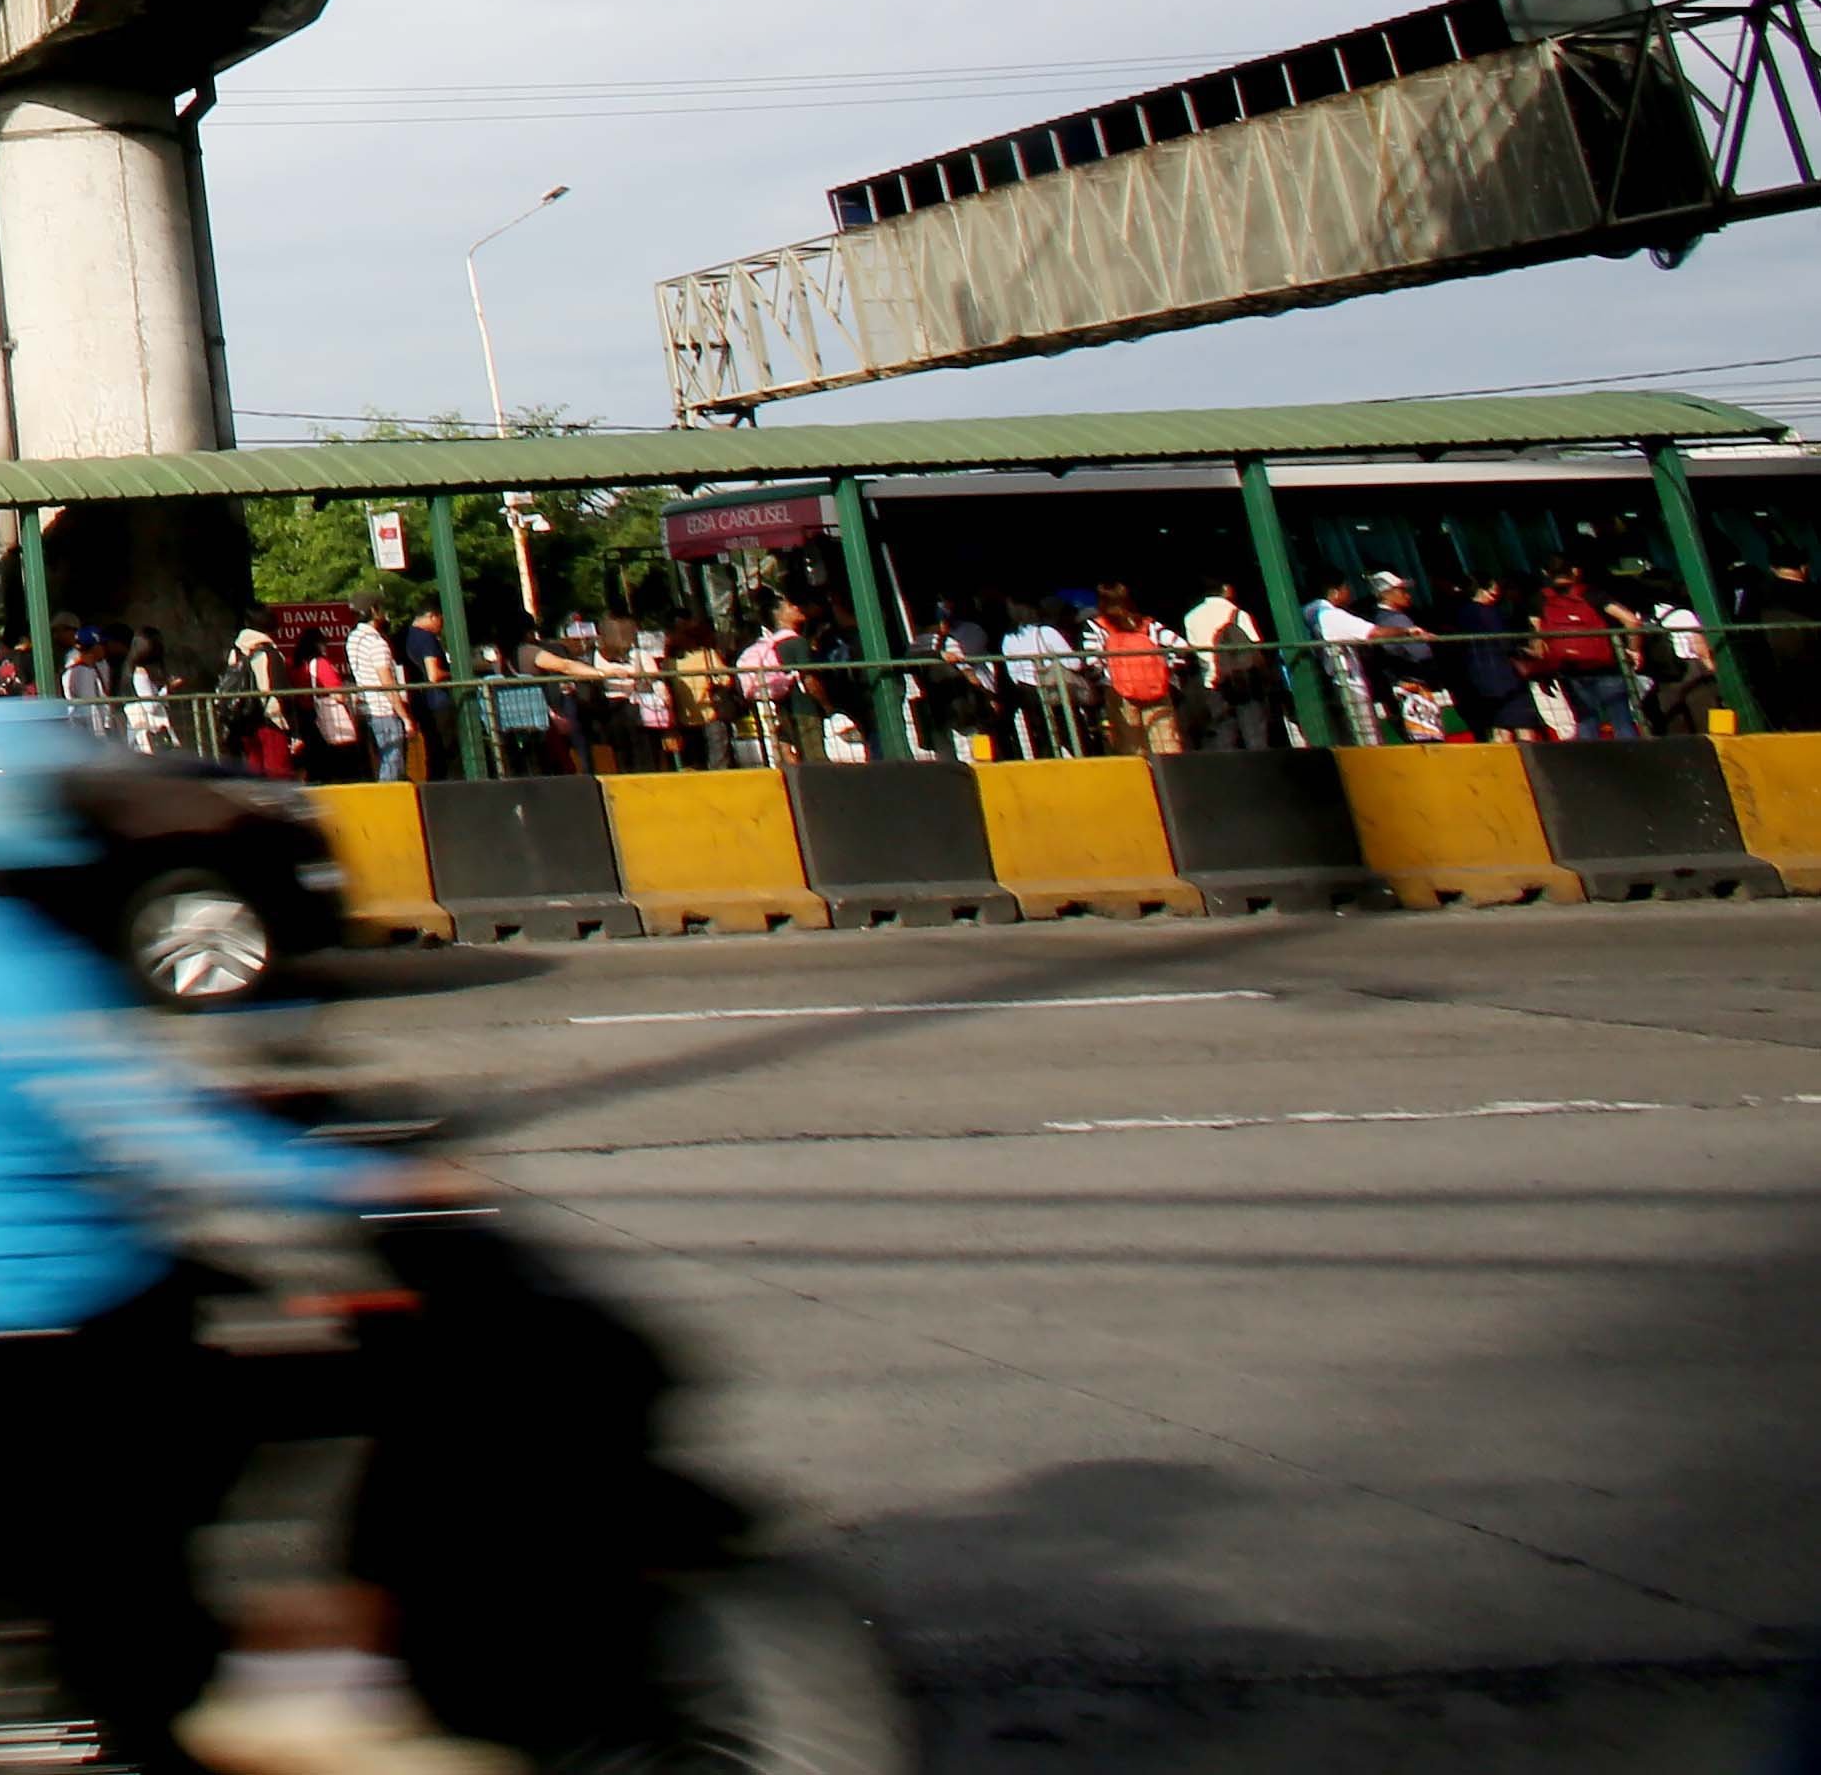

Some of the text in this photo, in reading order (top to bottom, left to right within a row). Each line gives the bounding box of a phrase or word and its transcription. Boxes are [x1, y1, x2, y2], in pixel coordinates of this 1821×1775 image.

[686, 504, 794, 535] EDSA CAROUSEL
[282, 609, 340, 624] BAWAL
[277, 624, 351, 640] TUWID
